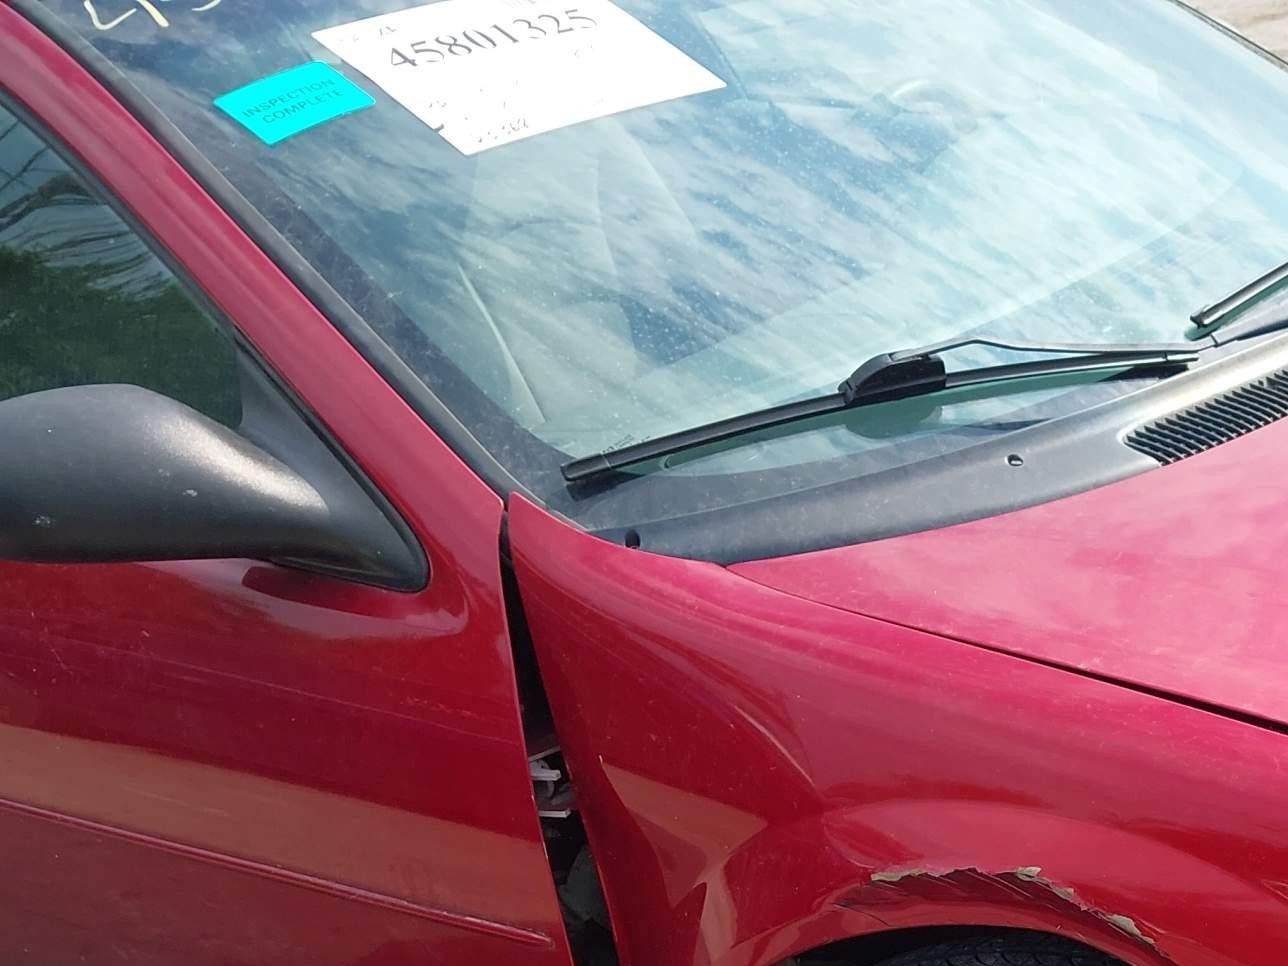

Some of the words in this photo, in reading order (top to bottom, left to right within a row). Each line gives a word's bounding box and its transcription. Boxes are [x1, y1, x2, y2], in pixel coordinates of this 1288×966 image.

[389, 8, 598, 68] 45801325
[242, 79, 335, 118] INSPECTION
[262, 88, 344, 124] COMPLETE
